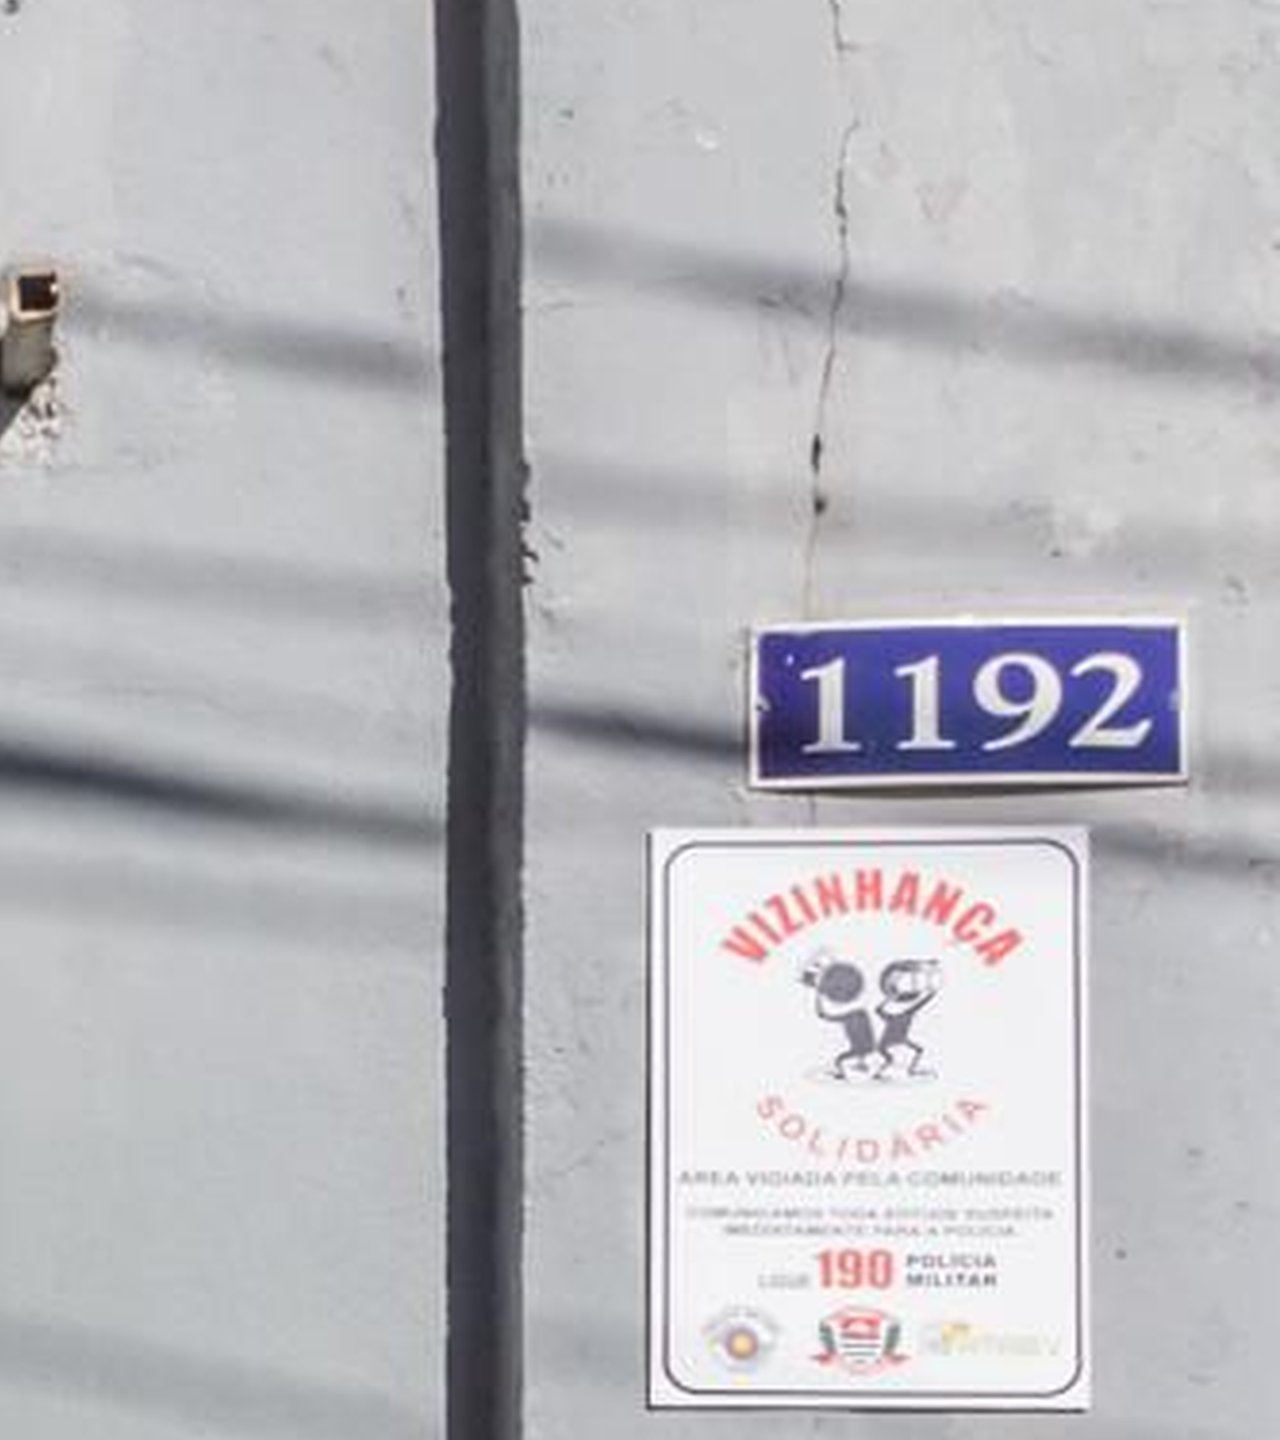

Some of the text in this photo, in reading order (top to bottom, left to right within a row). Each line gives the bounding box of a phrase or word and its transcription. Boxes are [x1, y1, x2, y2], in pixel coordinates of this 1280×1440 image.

[800, 651, 1154, 753] 1192
[814, 1248, 894, 1290] 190
[905, 1272, 998, 1288] MILITAR
